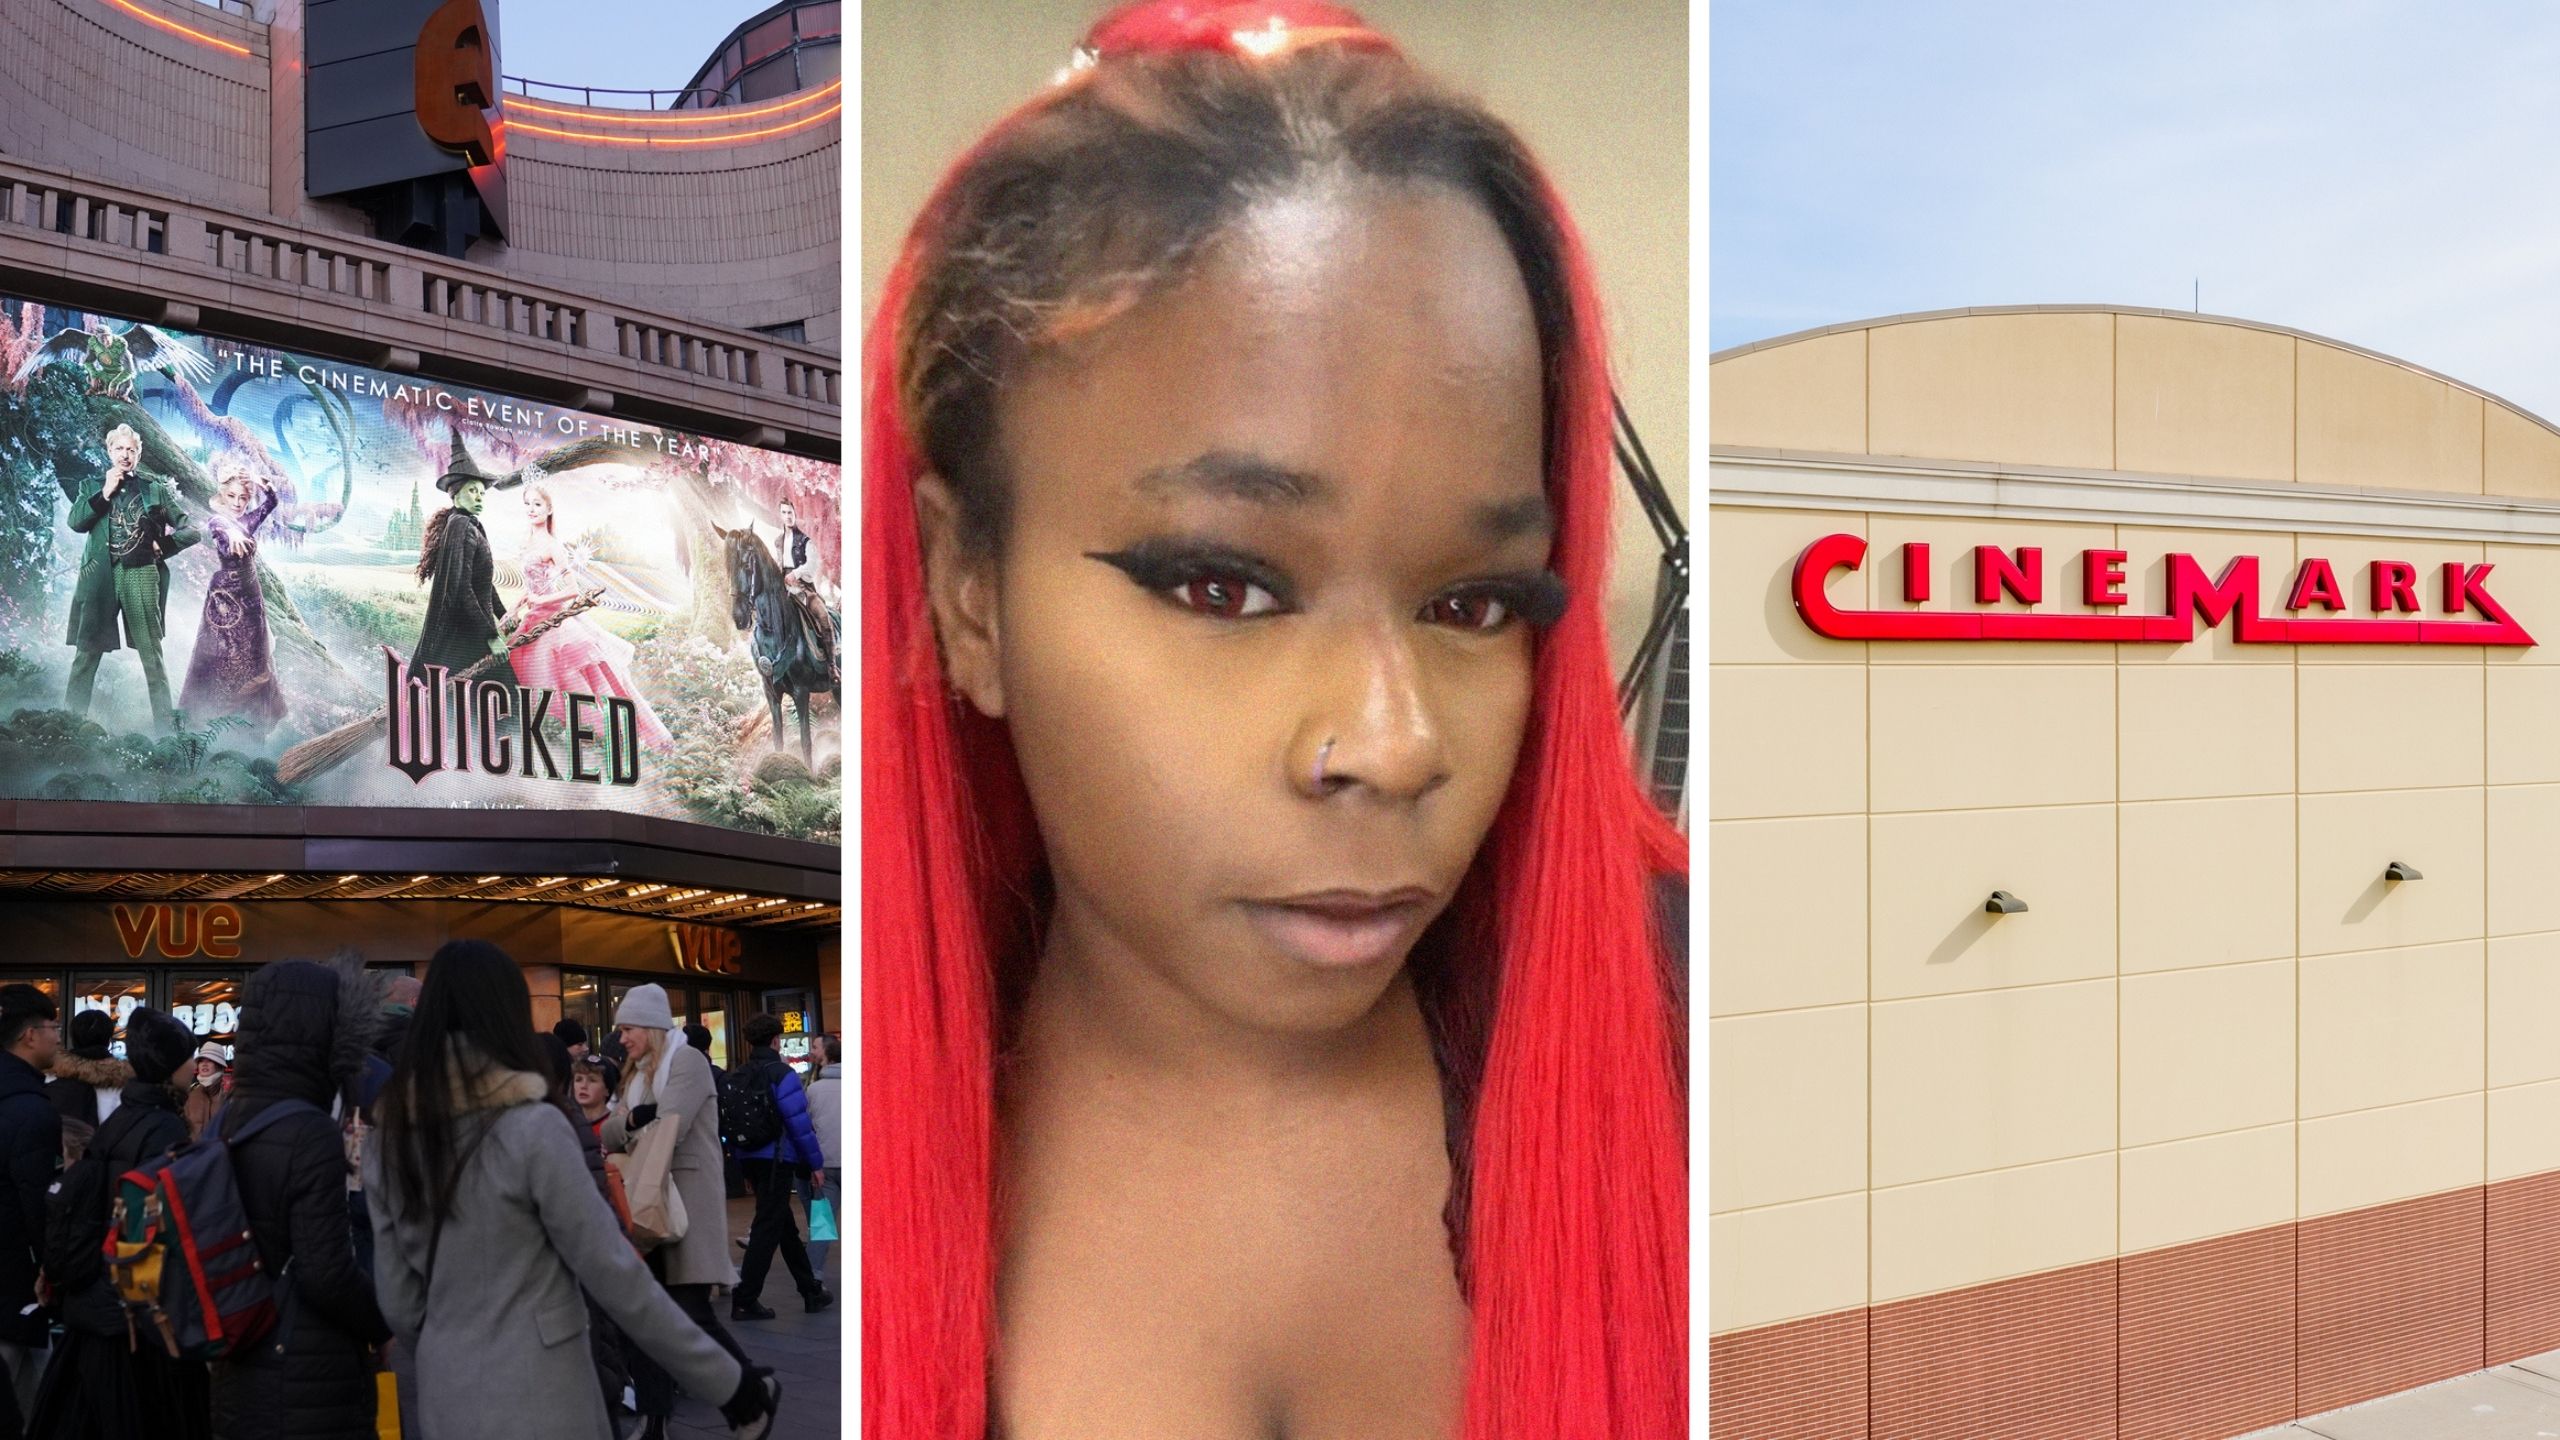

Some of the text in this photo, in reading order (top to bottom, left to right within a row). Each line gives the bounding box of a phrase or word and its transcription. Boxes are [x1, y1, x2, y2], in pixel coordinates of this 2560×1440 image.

[299, 365, 452, 410] CINEMATIC
[467, 397, 544, 429] EVENT
[557, 416, 588, 437] OF
[601, 424, 641, 448] THE
[1791, 533, 2539, 647] CINEMARK
[380, 644, 641, 788] WICKED
